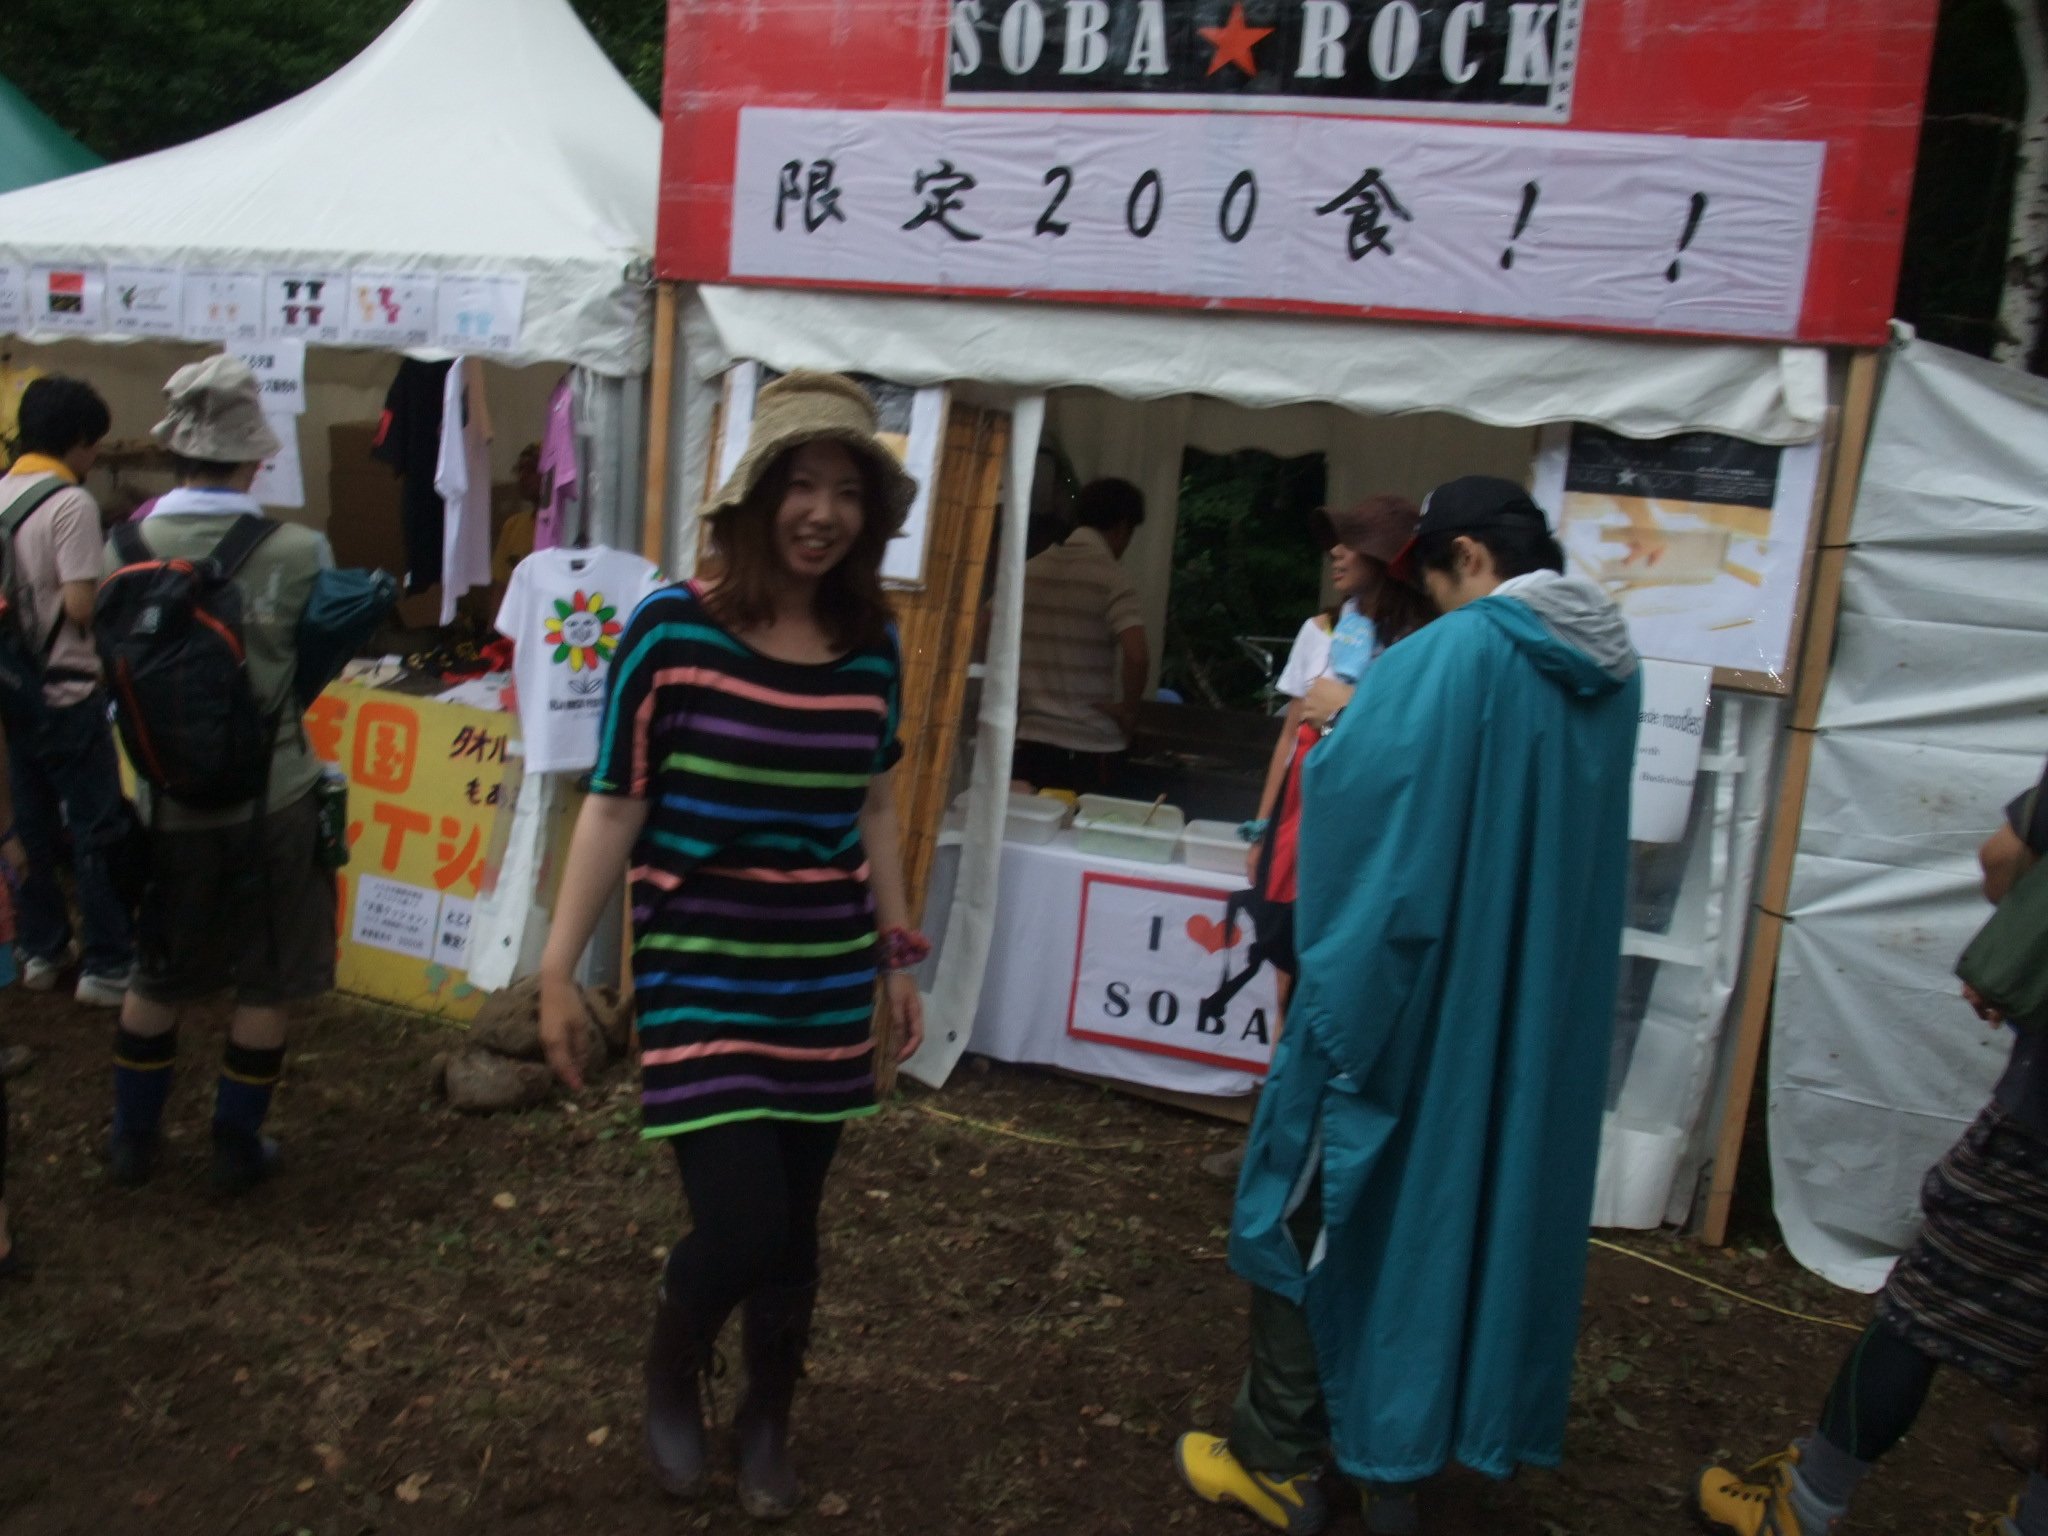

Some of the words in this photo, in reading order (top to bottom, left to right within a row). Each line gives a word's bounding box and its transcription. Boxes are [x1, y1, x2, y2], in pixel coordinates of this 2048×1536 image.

[949, 0, 1169, 77] SOBA
[1294, 0, 1555, 86] ROCK
[1148, 915, 1163, 951] I
[1103, 980, 1270, 1045] SOBA
